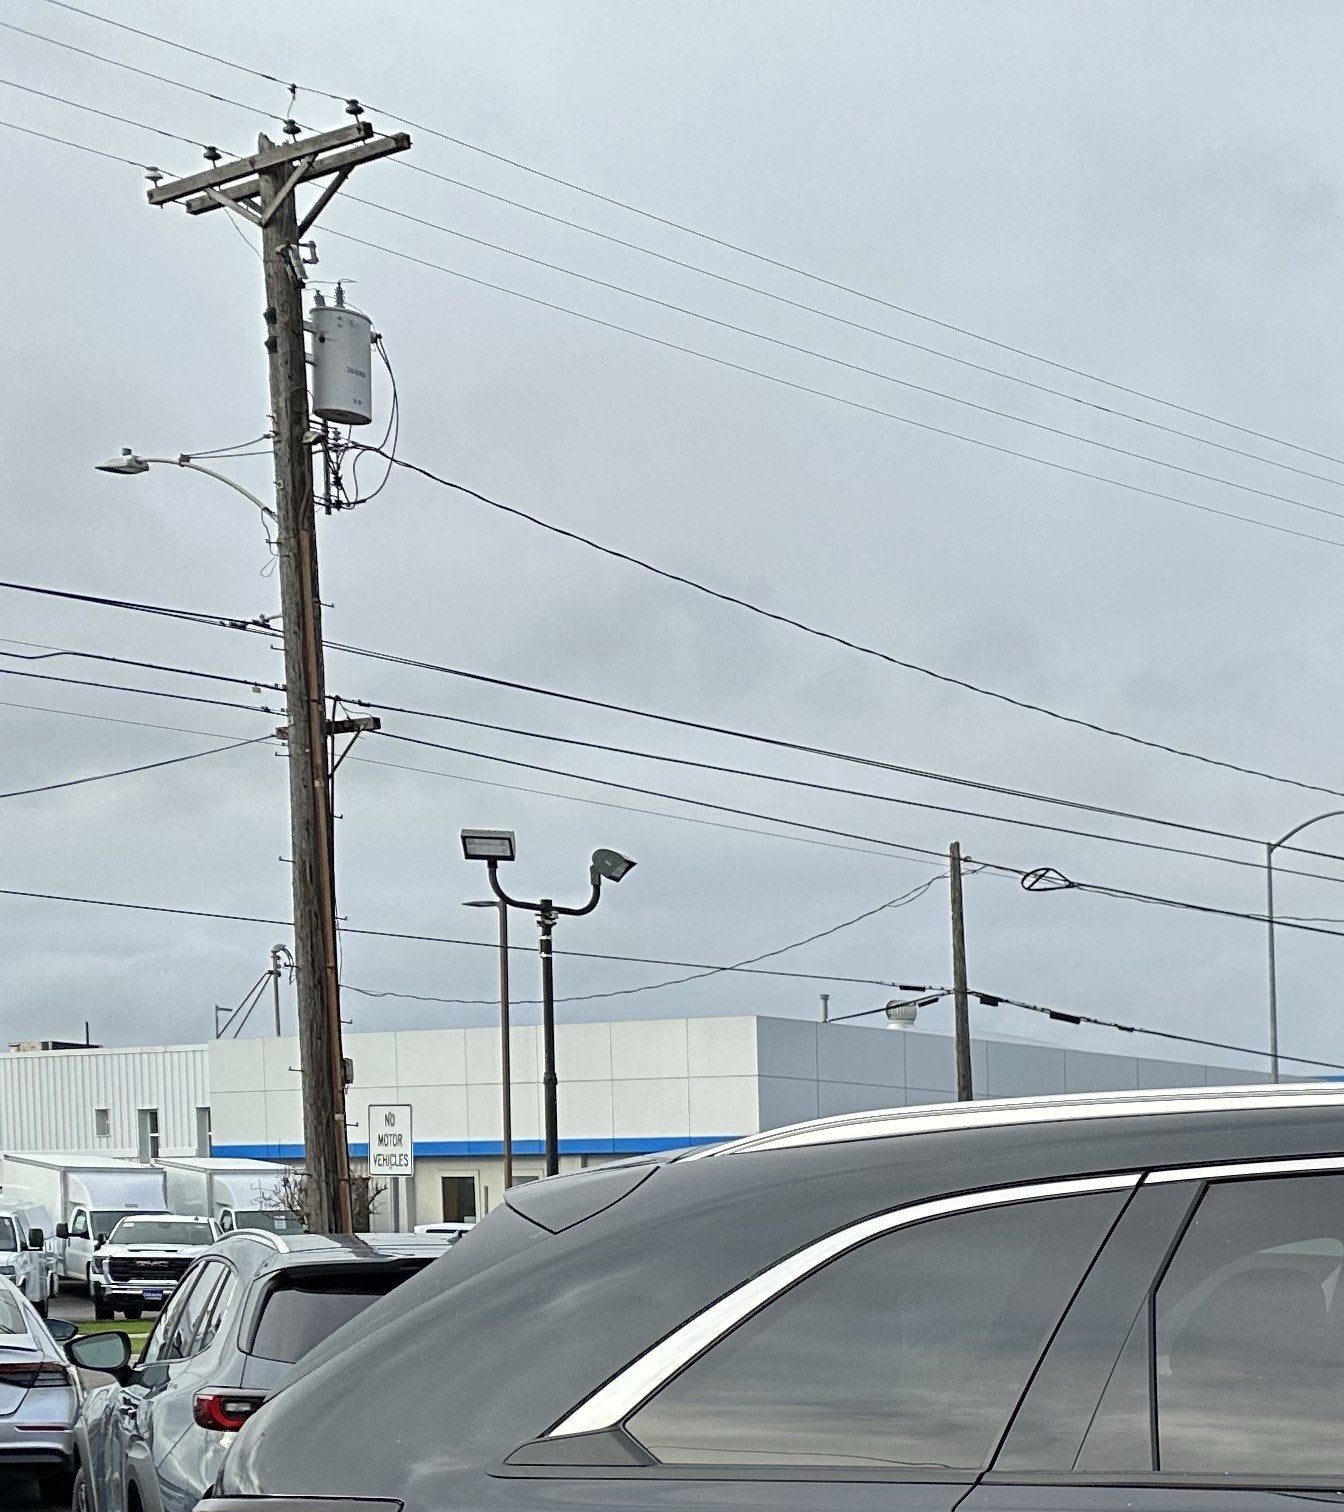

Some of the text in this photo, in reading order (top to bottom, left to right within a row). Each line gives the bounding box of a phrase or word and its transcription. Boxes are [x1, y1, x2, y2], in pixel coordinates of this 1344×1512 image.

[384, 1112, 396, 1127] NO
[377, 1133, 403, 1147] MOTOR
[373, 1153, 409, 1167] VEHICLES
